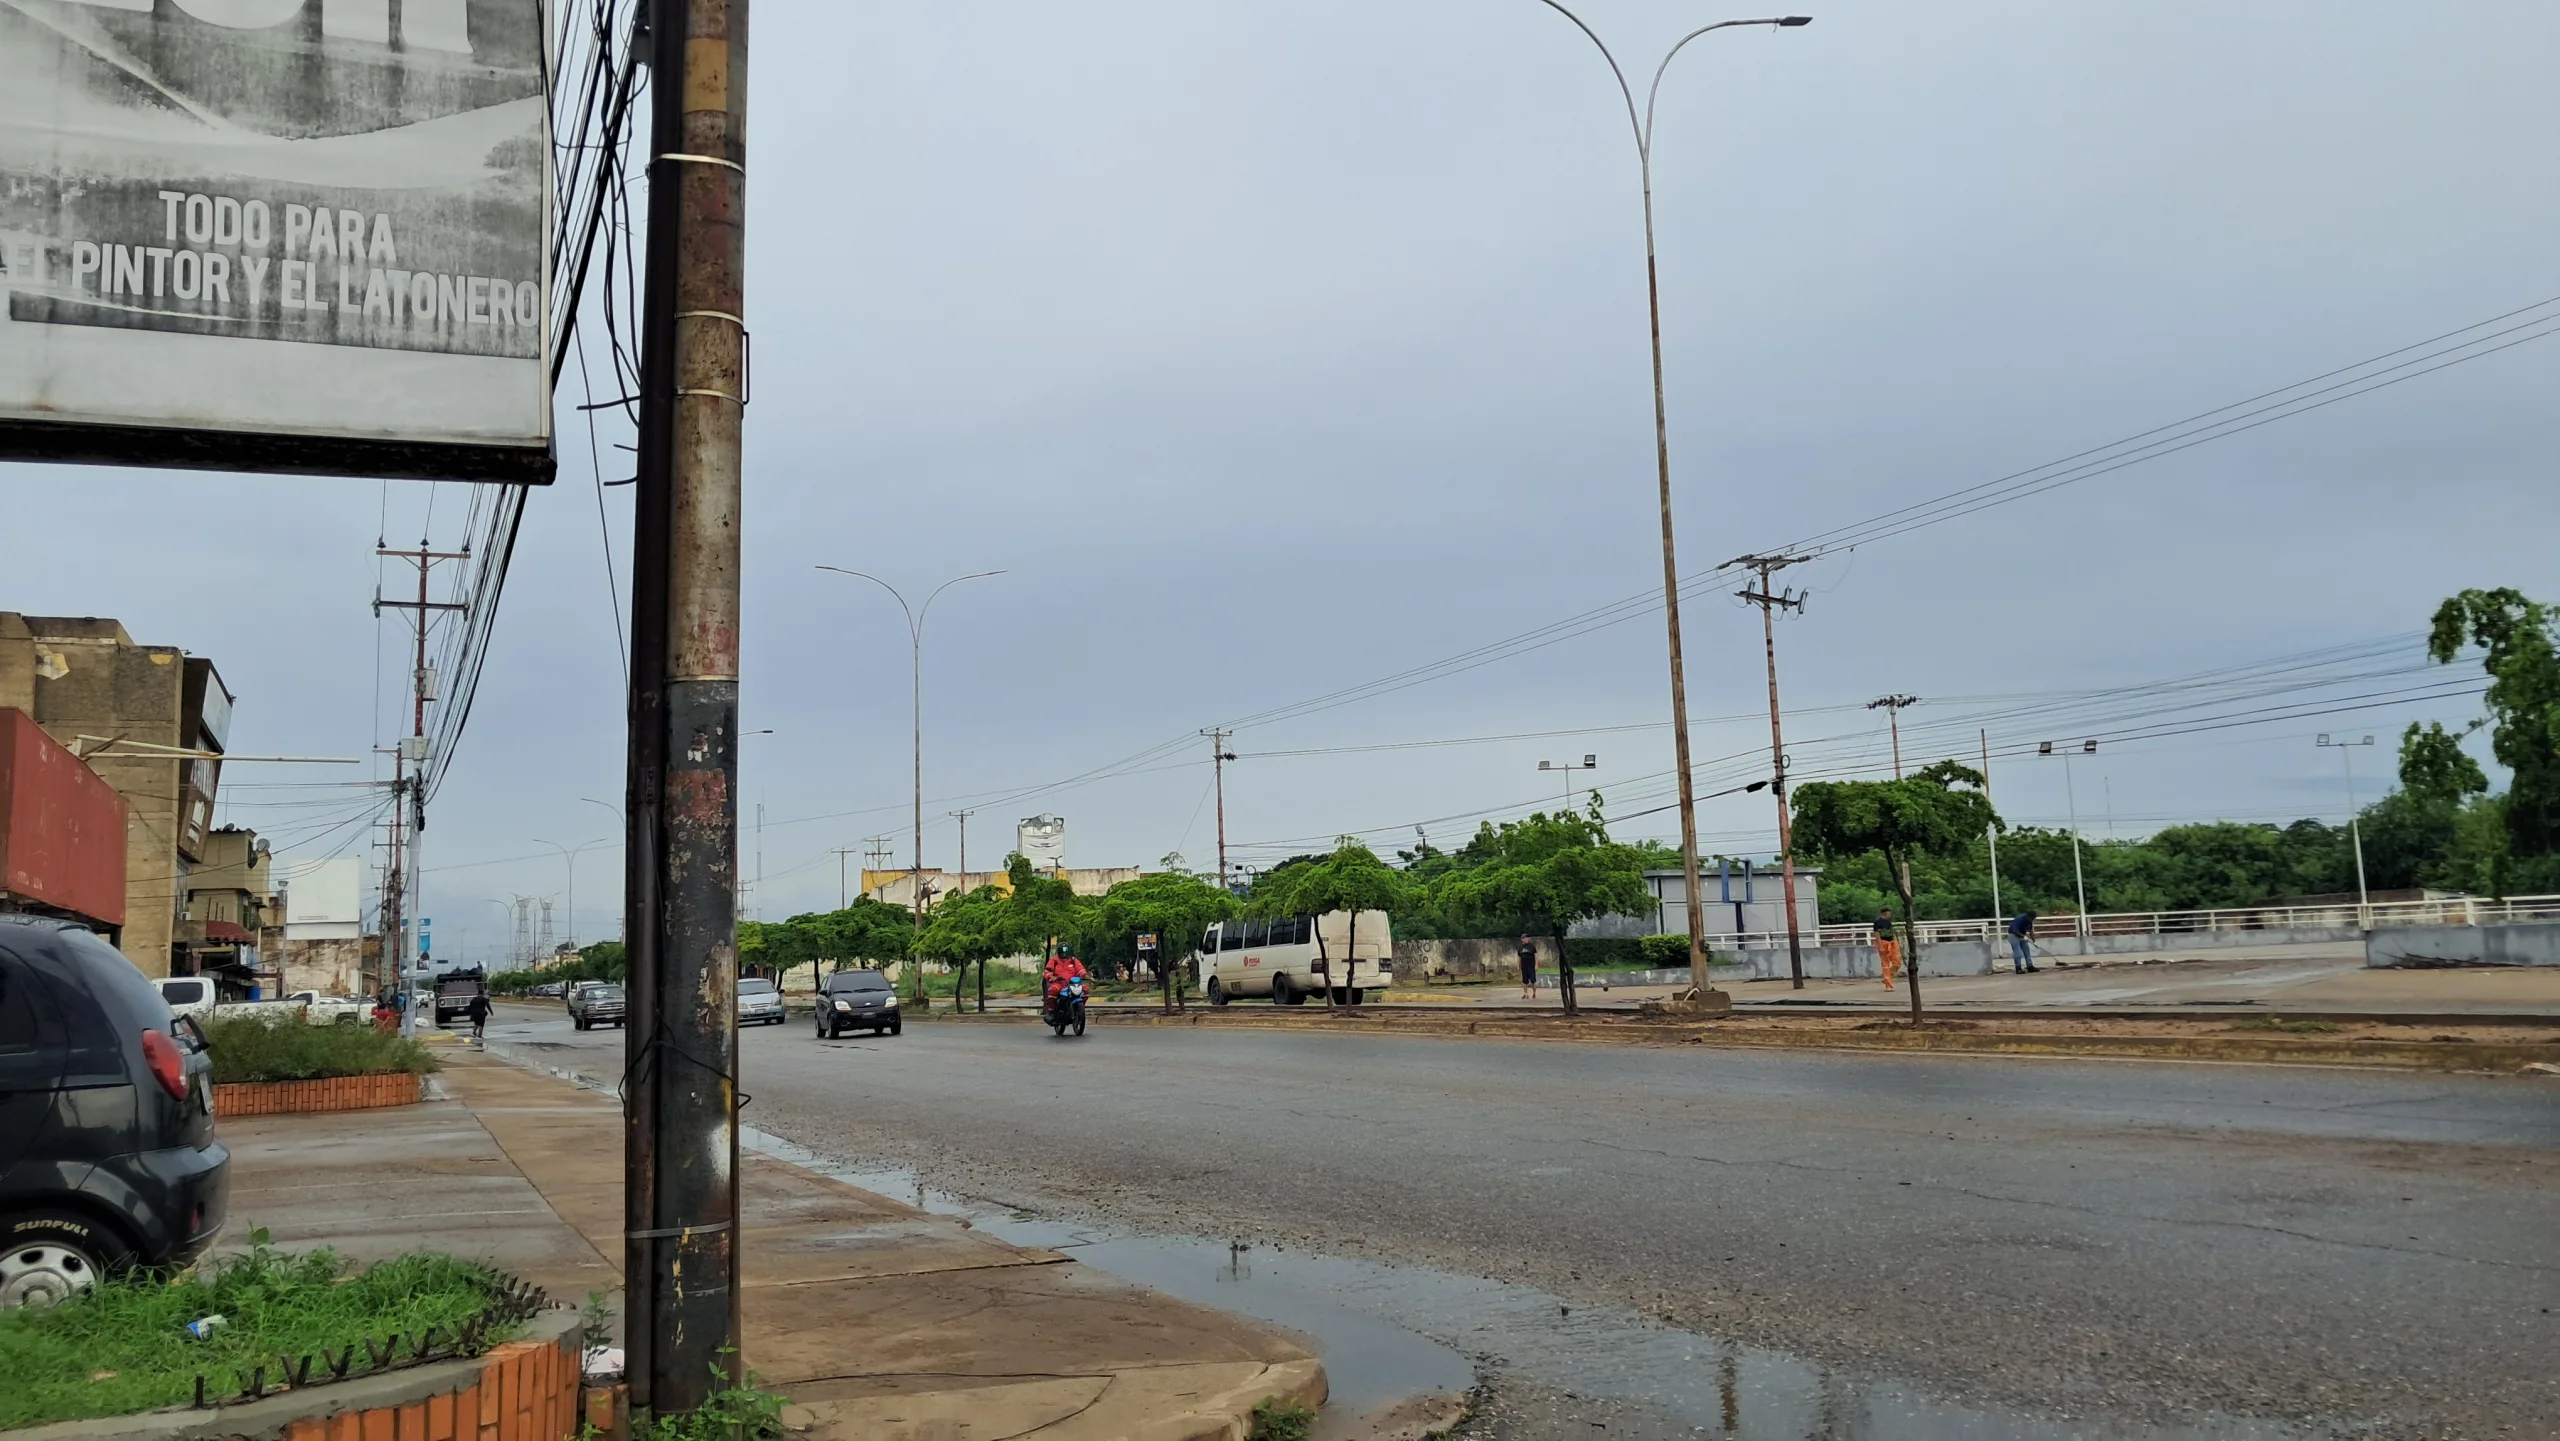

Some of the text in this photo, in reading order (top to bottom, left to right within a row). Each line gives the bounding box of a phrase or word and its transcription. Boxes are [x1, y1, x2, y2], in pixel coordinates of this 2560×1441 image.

[158, 190, 398, 262] TODO PARA
[71, 240, 231, 303] PINTOR
[240, 255, 271, 304] Y
[280, 258, 329, 311] EL
[338, 264, 541, 328] LATONERO
